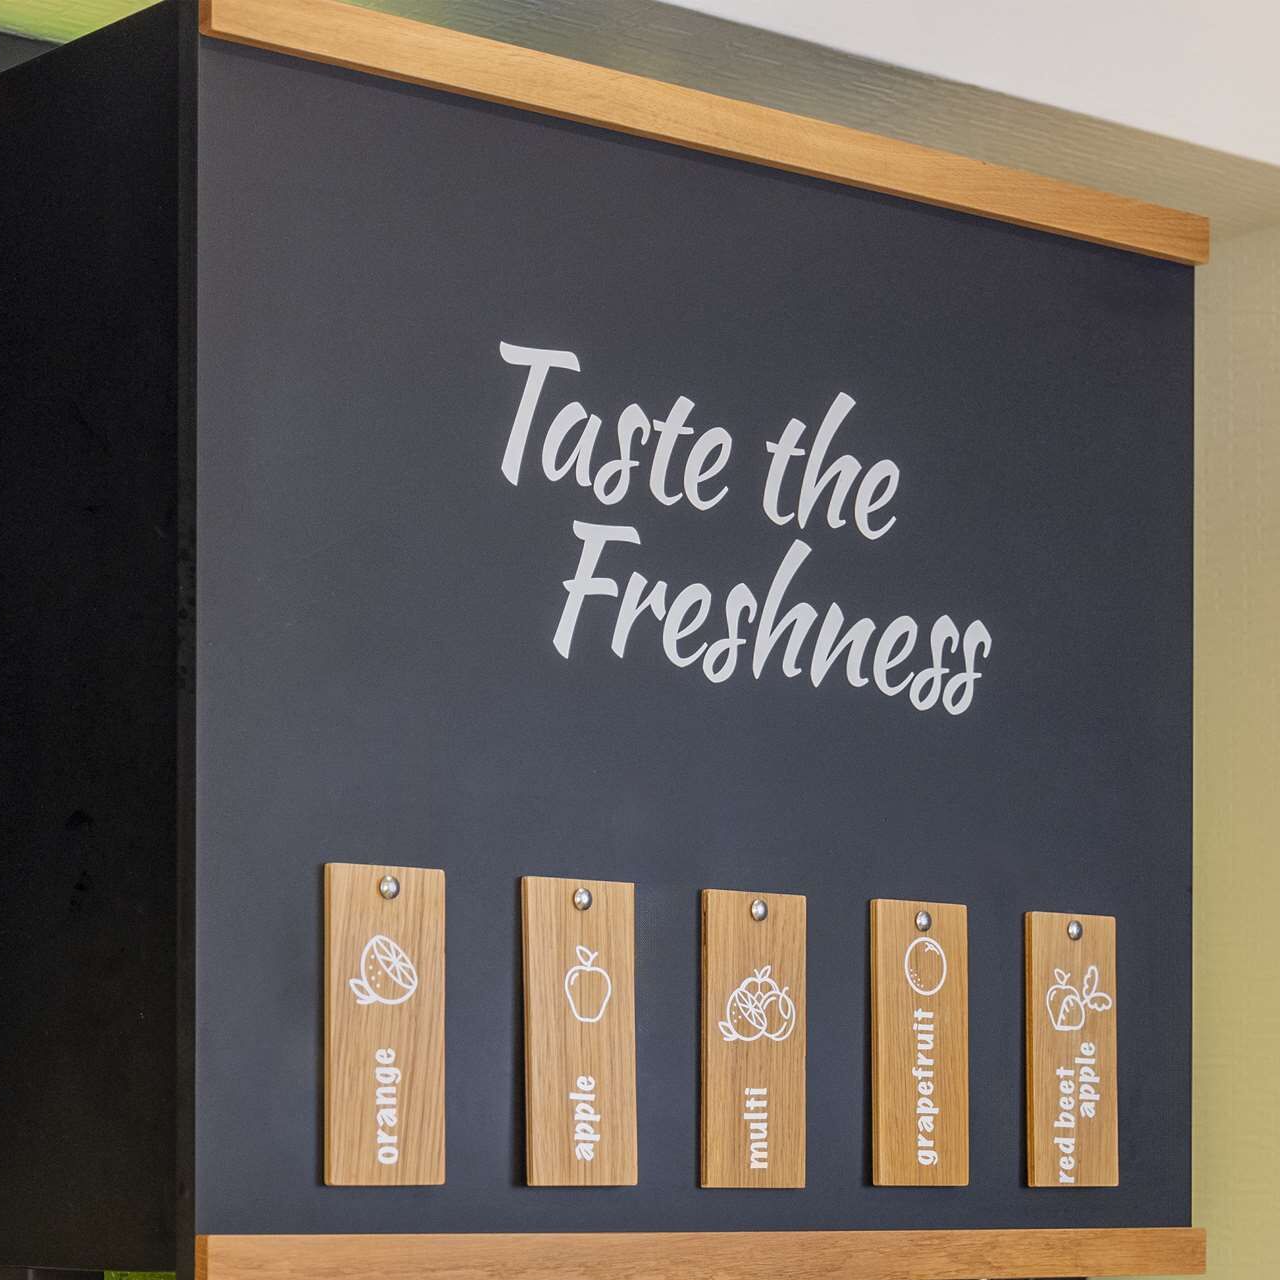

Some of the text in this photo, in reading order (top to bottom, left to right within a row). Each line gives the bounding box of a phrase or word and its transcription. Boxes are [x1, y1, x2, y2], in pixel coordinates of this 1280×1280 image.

[499, 340, 901, 540] Taste the
[552, 519, 993, 716] Freshness
[375, 1046, 402, 1165] orange
[569, 1074, 601, 1162] apple
[743, 1086, 769, 1170] multi
[911, 1007, 940, 1166] grapefruit
[1054, 1066, 1076, 1184] red beet
[1075, 1041, 1101, 1119] apple
